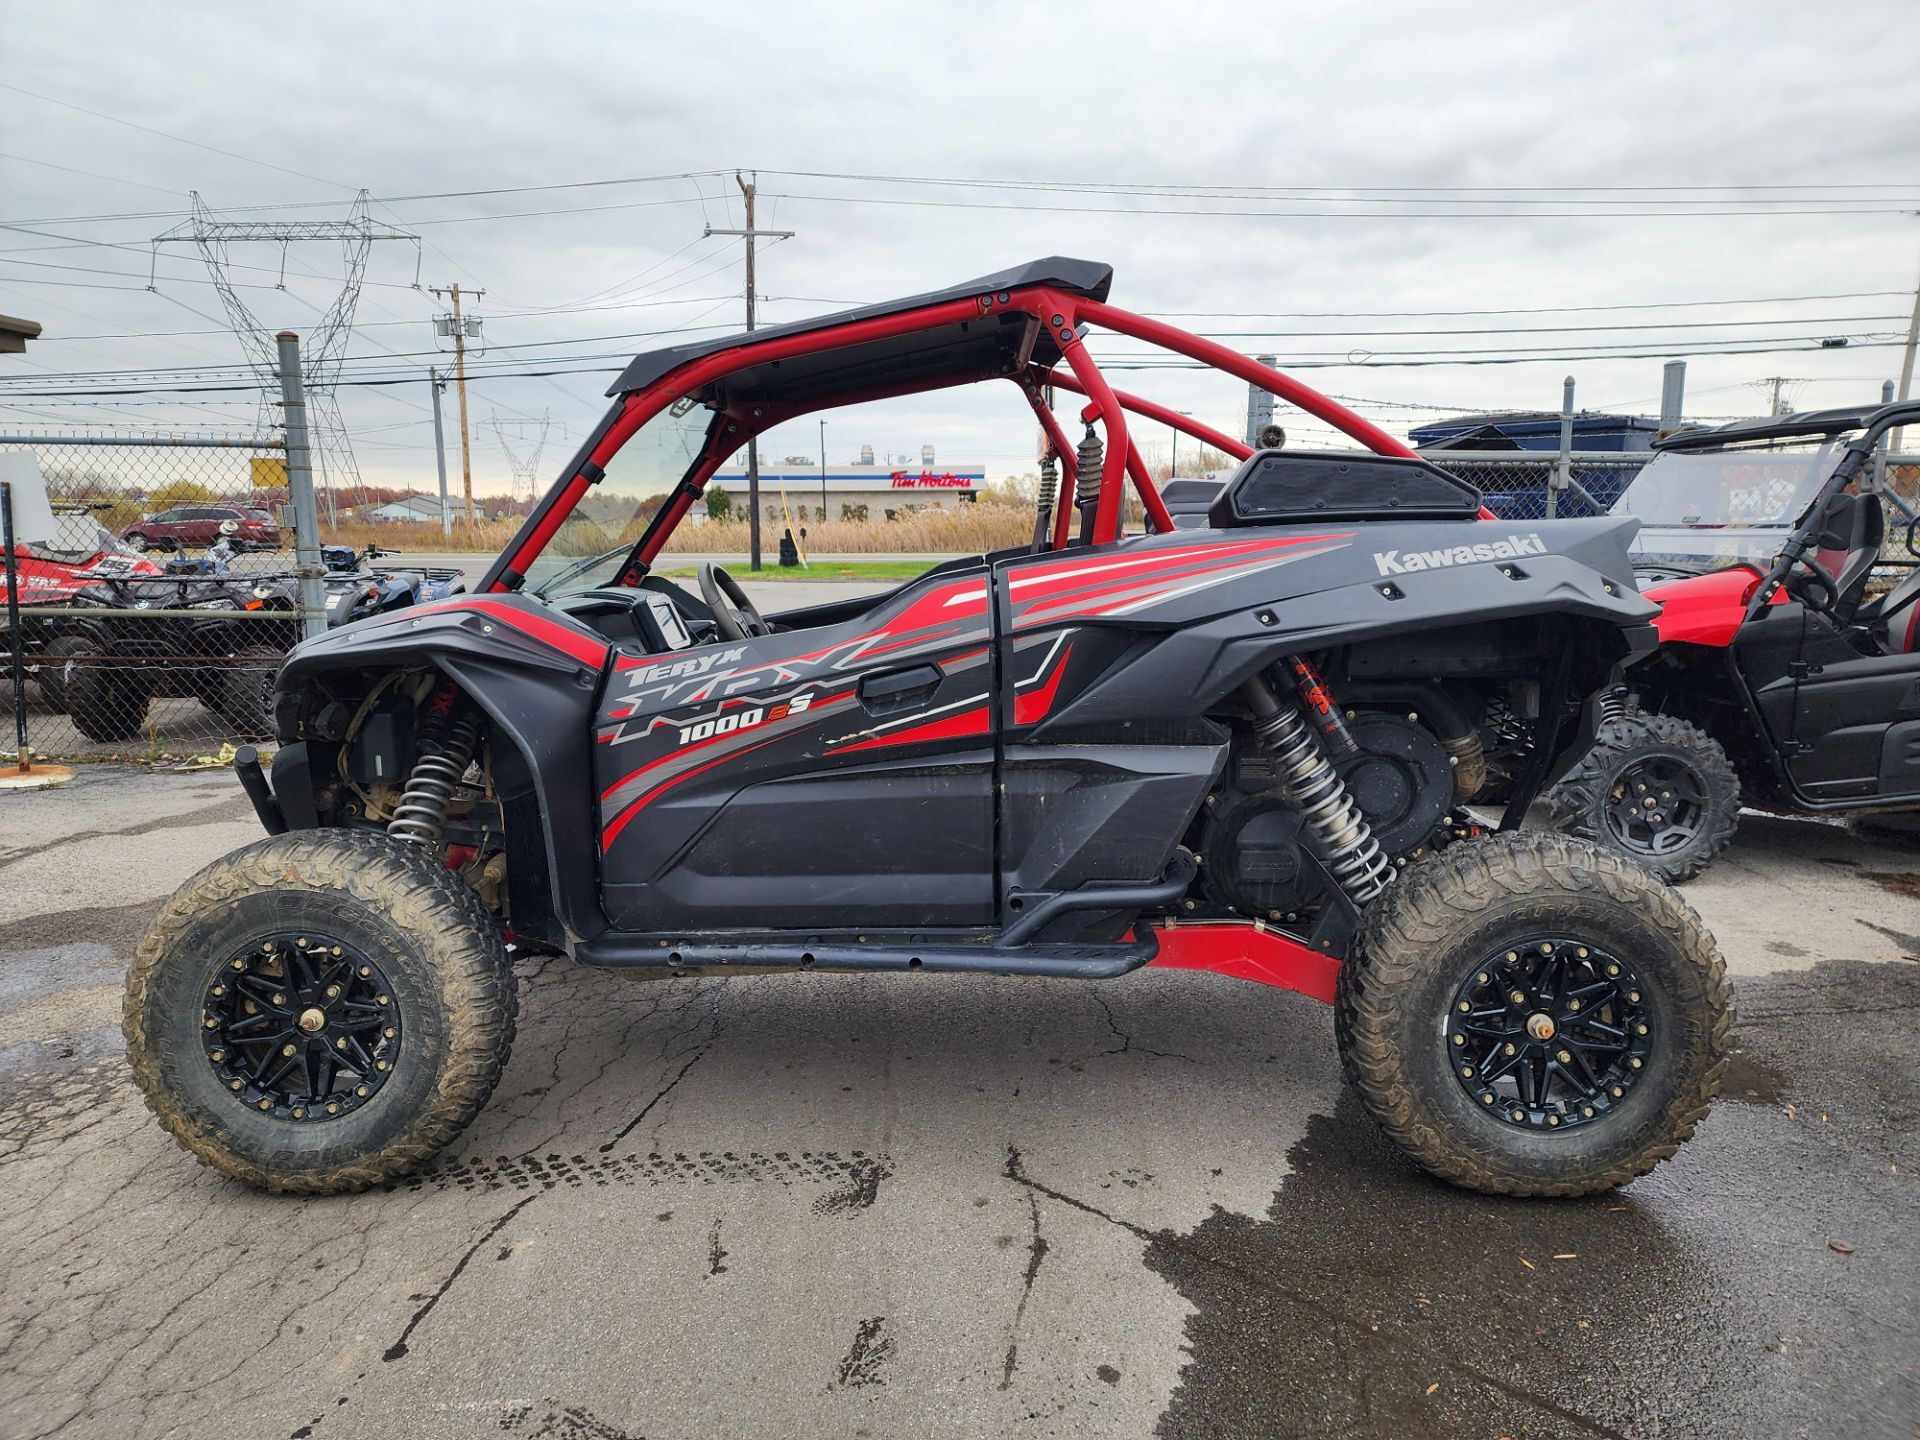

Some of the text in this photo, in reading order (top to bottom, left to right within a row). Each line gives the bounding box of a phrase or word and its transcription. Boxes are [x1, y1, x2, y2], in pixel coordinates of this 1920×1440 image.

[890, 470, 971, 488] Tim Hortons
[1373, 533, 1548, 577] Kawasaki
[679, 708, 763, 745] 1000
